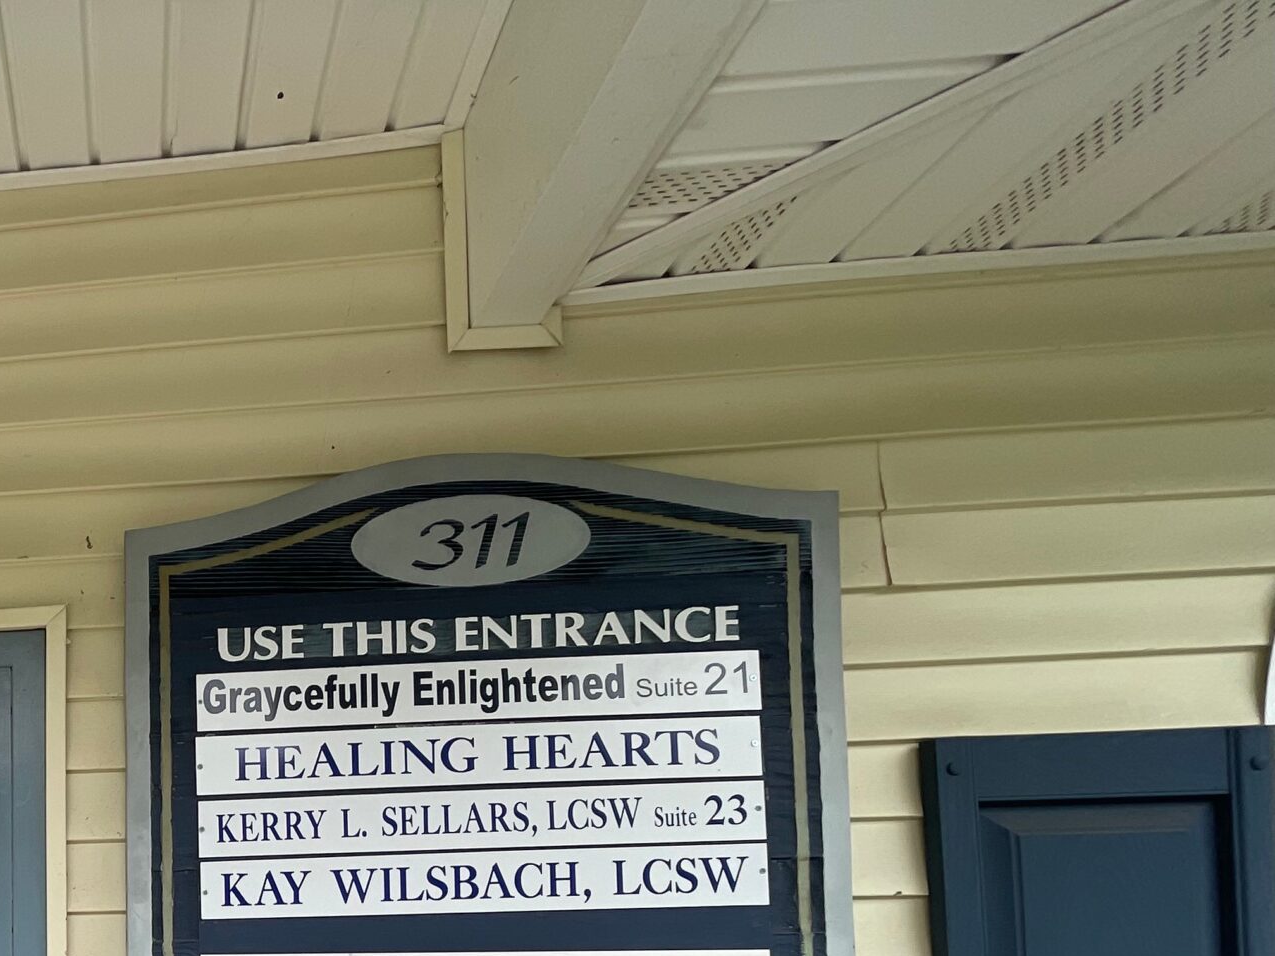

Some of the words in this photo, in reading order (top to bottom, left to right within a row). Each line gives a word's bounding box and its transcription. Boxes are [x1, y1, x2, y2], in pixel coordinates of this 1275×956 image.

[411, 511, 531, 571] 311
[217, 625, 304, 662] USE
[323, 618, 436, 657] THIS
[455, 605, 740, 652] ENTRANCE
[202, 670, 400, 721] Graycefully
[413, 663, 625, 713] Enlightened
[636, 677, 698, 698] Suite
[703, 661, 750, 695] 21
[235, 737, 478, 781] HEALING
[503, 728, 721, 771] HEARTS
[216, 809, 327, 844] KERRY
[341, 809, 368, 838] L.
[381, 801, 539, 838] SELLARS,
[548, 797, 642, 831] LCSW
[654, 806, 697, 828] Suite
[704, 794, 748, 826] 23
[221, 870, 312, 907] KAY
[331, 861, 592, 904] WILSBACH,
[613, 856, 749, 895] LCSW
